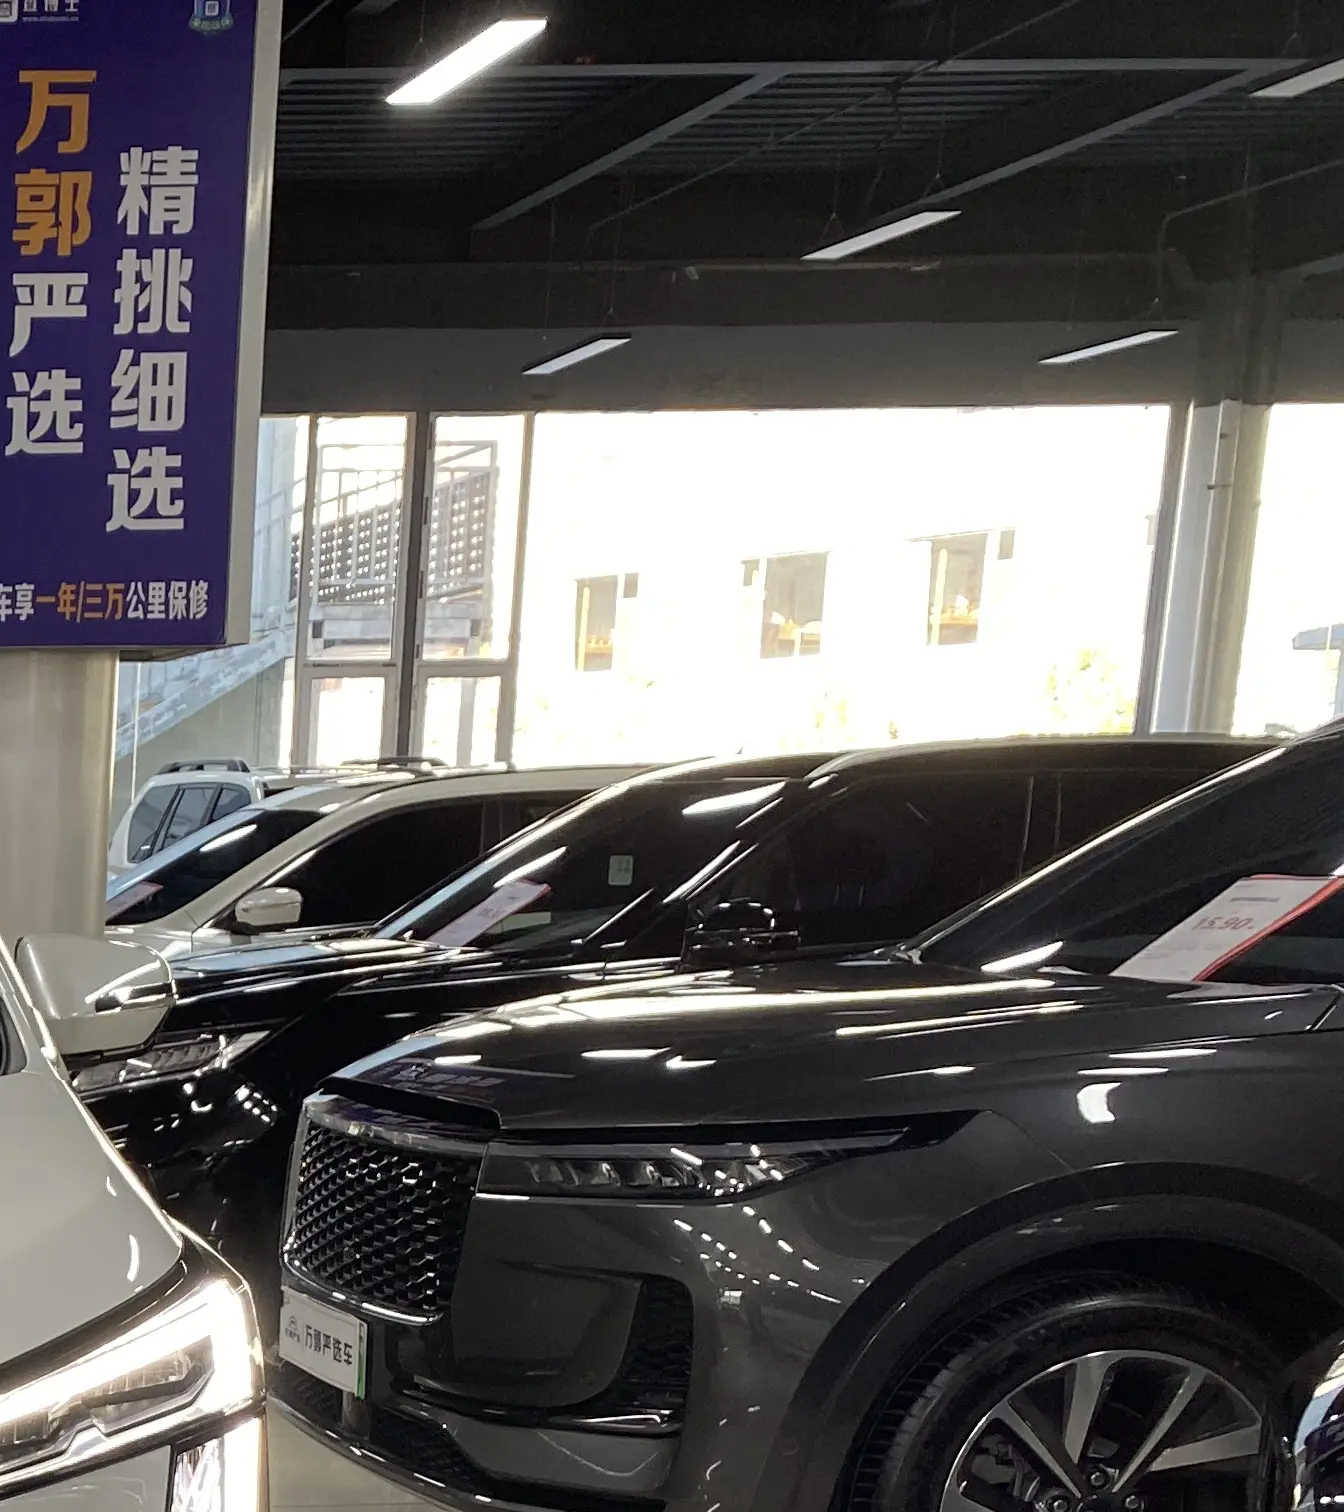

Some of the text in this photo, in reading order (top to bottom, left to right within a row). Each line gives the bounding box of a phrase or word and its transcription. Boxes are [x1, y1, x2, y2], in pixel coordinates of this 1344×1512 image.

[5, 70, 97, 456] 万郭严选
[106, 146, 200, 532] 精挑细选
